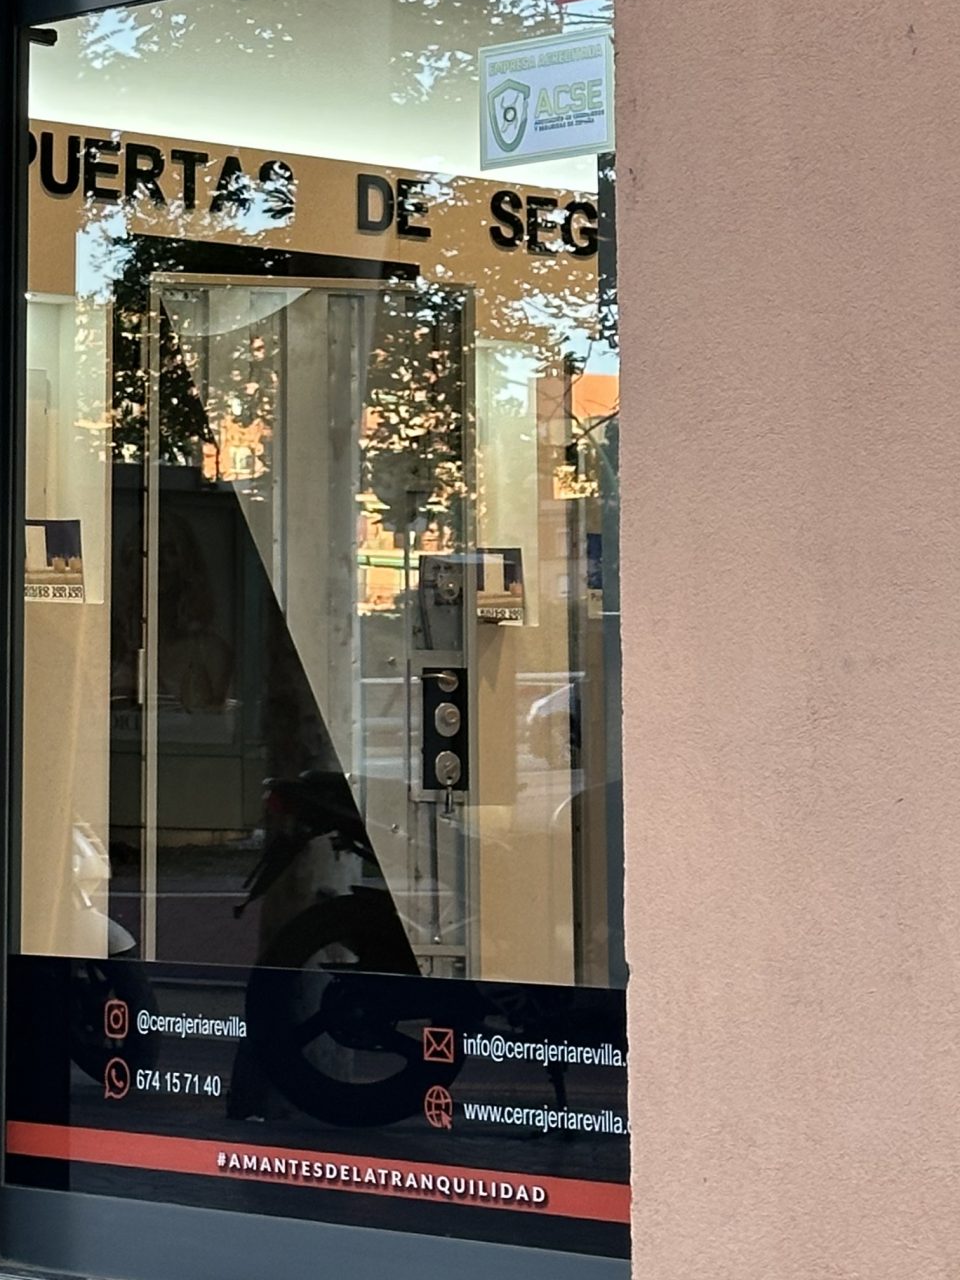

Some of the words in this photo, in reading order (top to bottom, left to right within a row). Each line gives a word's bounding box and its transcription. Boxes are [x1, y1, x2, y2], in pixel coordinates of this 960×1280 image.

[534, 78, 603, 119] ACSE
[29, 131, 295, 220] UERTAS
[357, 173, 431, 238] DE
[490, 190, 598, 257] SEG
[136, 1009, 248, 1039] @cerrajeriarevilla
[136, 1068, 160, 1091] 674
[165, 1071, 181, 1093] 15
[183, 1072, 199, 1094] 71
[203, 1075, 221, 1097] 40
[216, 1151, 547, 1203] #AMANTESDELATRANQUILIDAD
